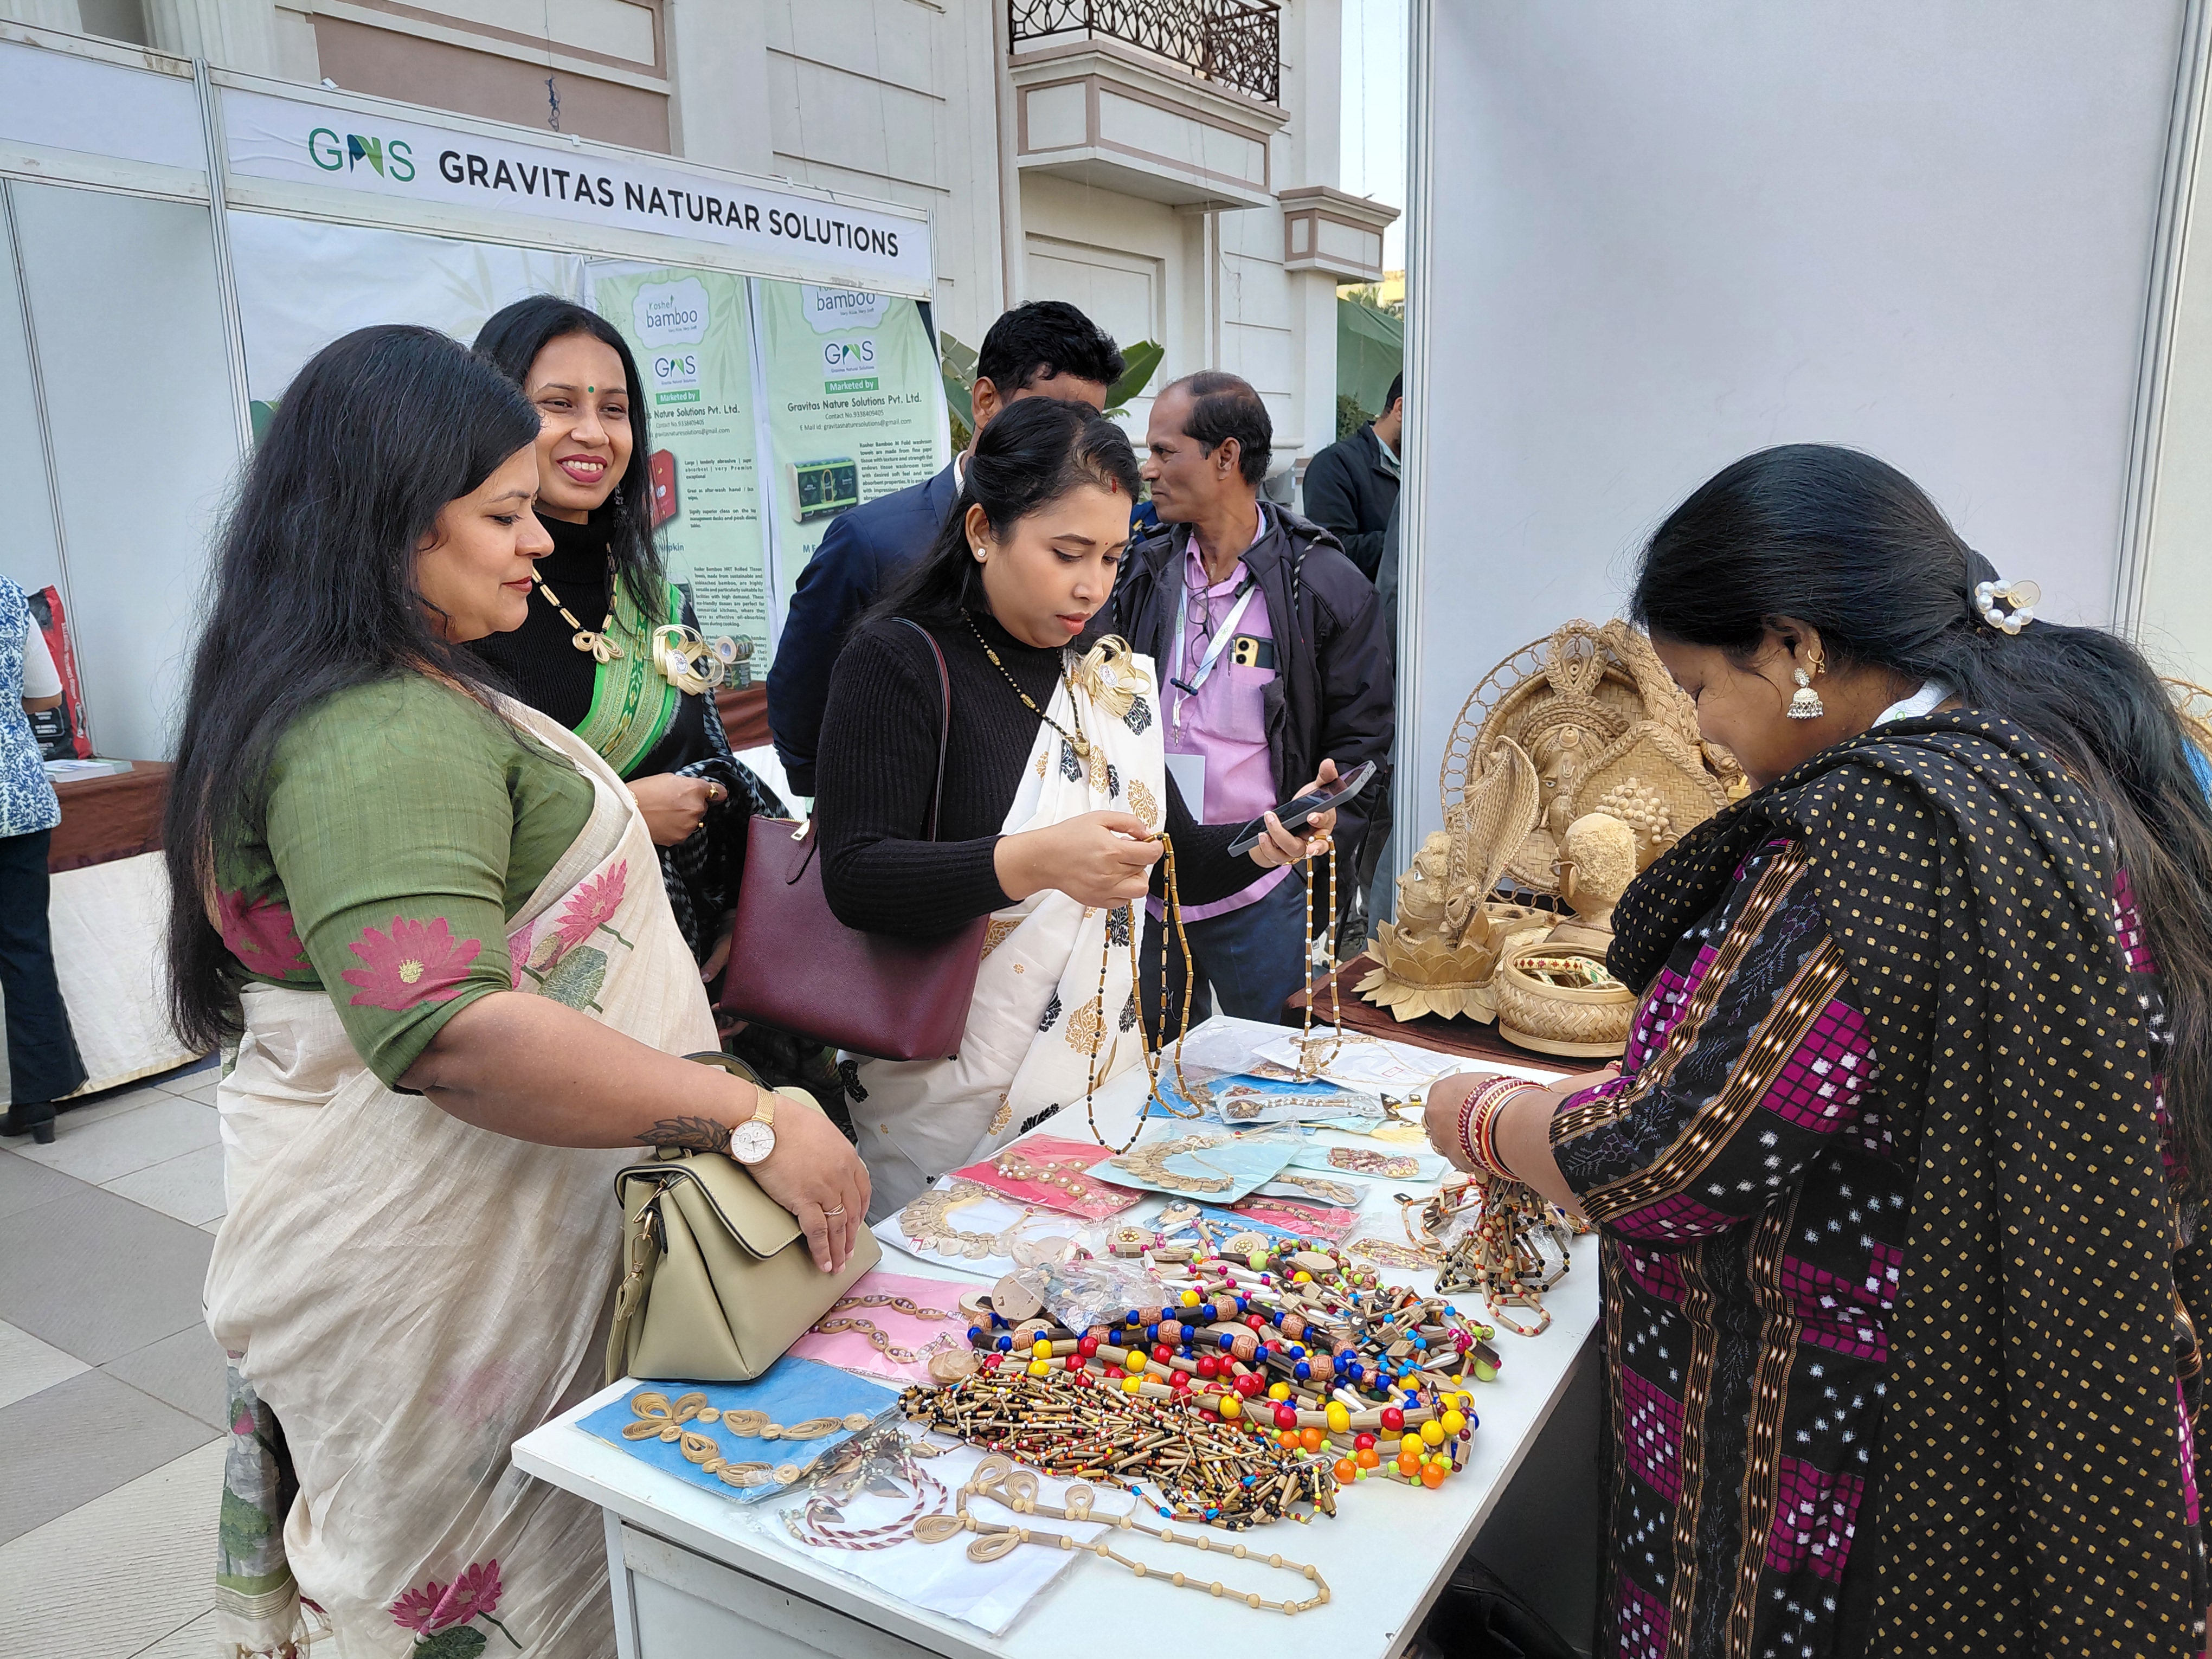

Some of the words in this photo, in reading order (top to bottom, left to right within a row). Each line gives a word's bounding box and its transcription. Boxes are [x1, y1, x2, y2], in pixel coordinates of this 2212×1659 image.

[308, 127, 415, 182] GNS
[439, 150, 615, 208] GRAVITAS
[626, 183, 761, 233] NATURAR
[769, 209, 898, 257] SOLUTIONS
[648, 295, 674, 310] Kosher
[816, 290, 875, 311] bamboo
[646, 306, 698, 328] bamboo
[825, 340, 873, 365] GNS
[655, 355, 696, 377] GNS
[829, 380, 864, 391] Marketed
[865, 380, 874, 390] by
[660, 392, 687, 402] Marketed
[688, 391, 696, 401] by
[787, 401, 821, 412] Gravitas
[823, 400, 849, 410] Nature
[852, 396, 885, 408] Solutions
[888, 395, 903, 404] Pvt.
[906, 393, 922, 403] Ltd.
[654, 410, 675, 419] Nature
[677, 407, 706, 417] Solutions
[708, 406, 722, 415] Pvt.
[724, 404, 740, 414] Ltd.
[659, 543, 684, 553] Npkin
[1215, 623, 1231, 646] BAMBOO
